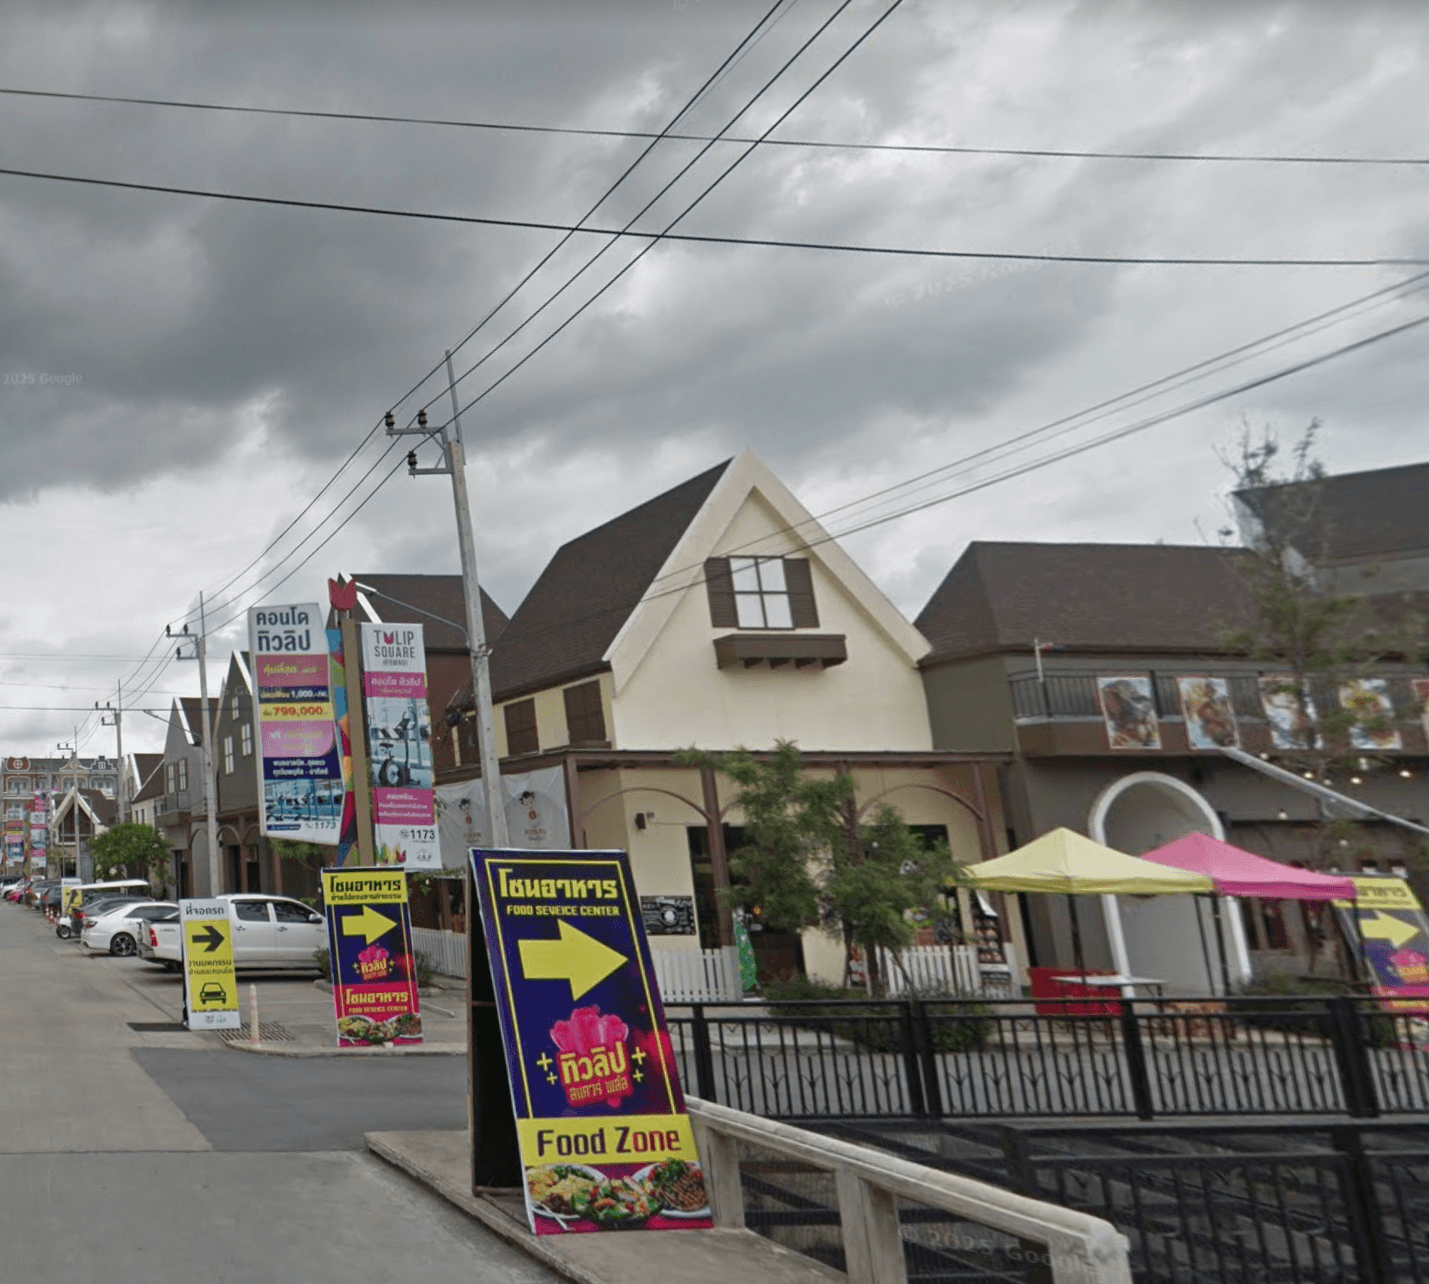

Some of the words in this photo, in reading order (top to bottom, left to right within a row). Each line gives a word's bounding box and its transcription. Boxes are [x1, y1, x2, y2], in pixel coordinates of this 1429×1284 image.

[256, 606, 309, 626] คอนโด
[257, 629, 311, 652] ทิวลิป
[373, 629, 414, 646] TULIP
[374, 645, 416, 659] SQUARE
[411, 829, 436, 840] 1173
[507, 905, 534, 915] FOOD
[580, 905, 620, 916] CENTER
[560, 1041, 626, 1084] ทิวลิป
[537, 1127, 606, 1157] Food
[614, 1126, 681, 1154] Zone
